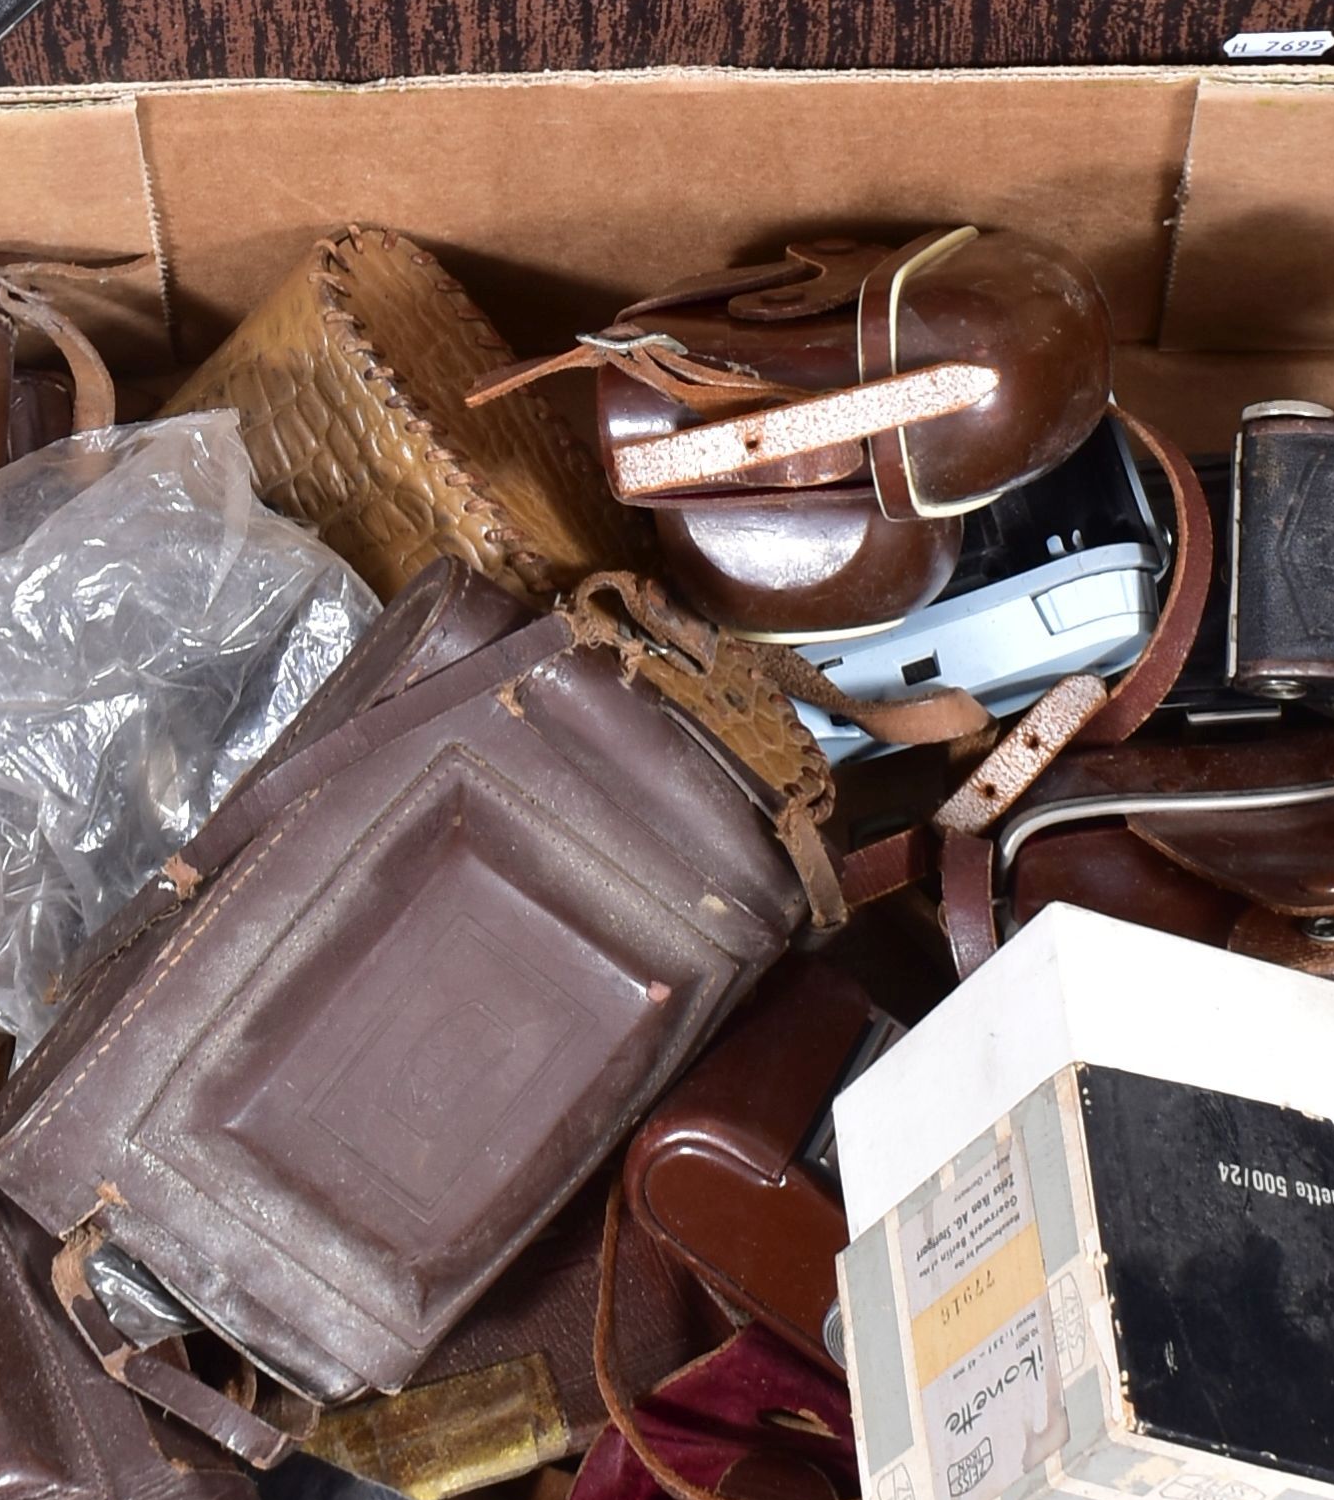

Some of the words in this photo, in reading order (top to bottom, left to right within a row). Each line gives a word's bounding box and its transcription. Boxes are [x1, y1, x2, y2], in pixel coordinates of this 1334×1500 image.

[1232, 43, 1247, 53] H
[1265, 40, 1326, 52] 7695
[993, 1154, 1010, 1171] Made
[954, 1177, 983, 1202] Germany
[993, 1173, 1015, 1197] Zeiss
[1218, 1161, 1288, 1198] 500/24
[971, 1195, 990, 1213] Ikon
[954, 1211, 968, 1230] AG.
[969, 1195, 1017, 1239] Goerzwerk
[916, 1226, 952, 1262] Stuttgart
[976, 1212, 1020, 1251] Manufactured
[940, 1236, 967, 1262] Berlin
[919, 1267, 930, 1278] the
[954, 1258, 965, 1269] the
[1066, 1293, 1085, 1346] ZEISS
[944, 1345, 1044, 1435] ikonette
[957, 1448, 981, 1473] IKON
[957, 1460, 986, 1494] ZEISS
